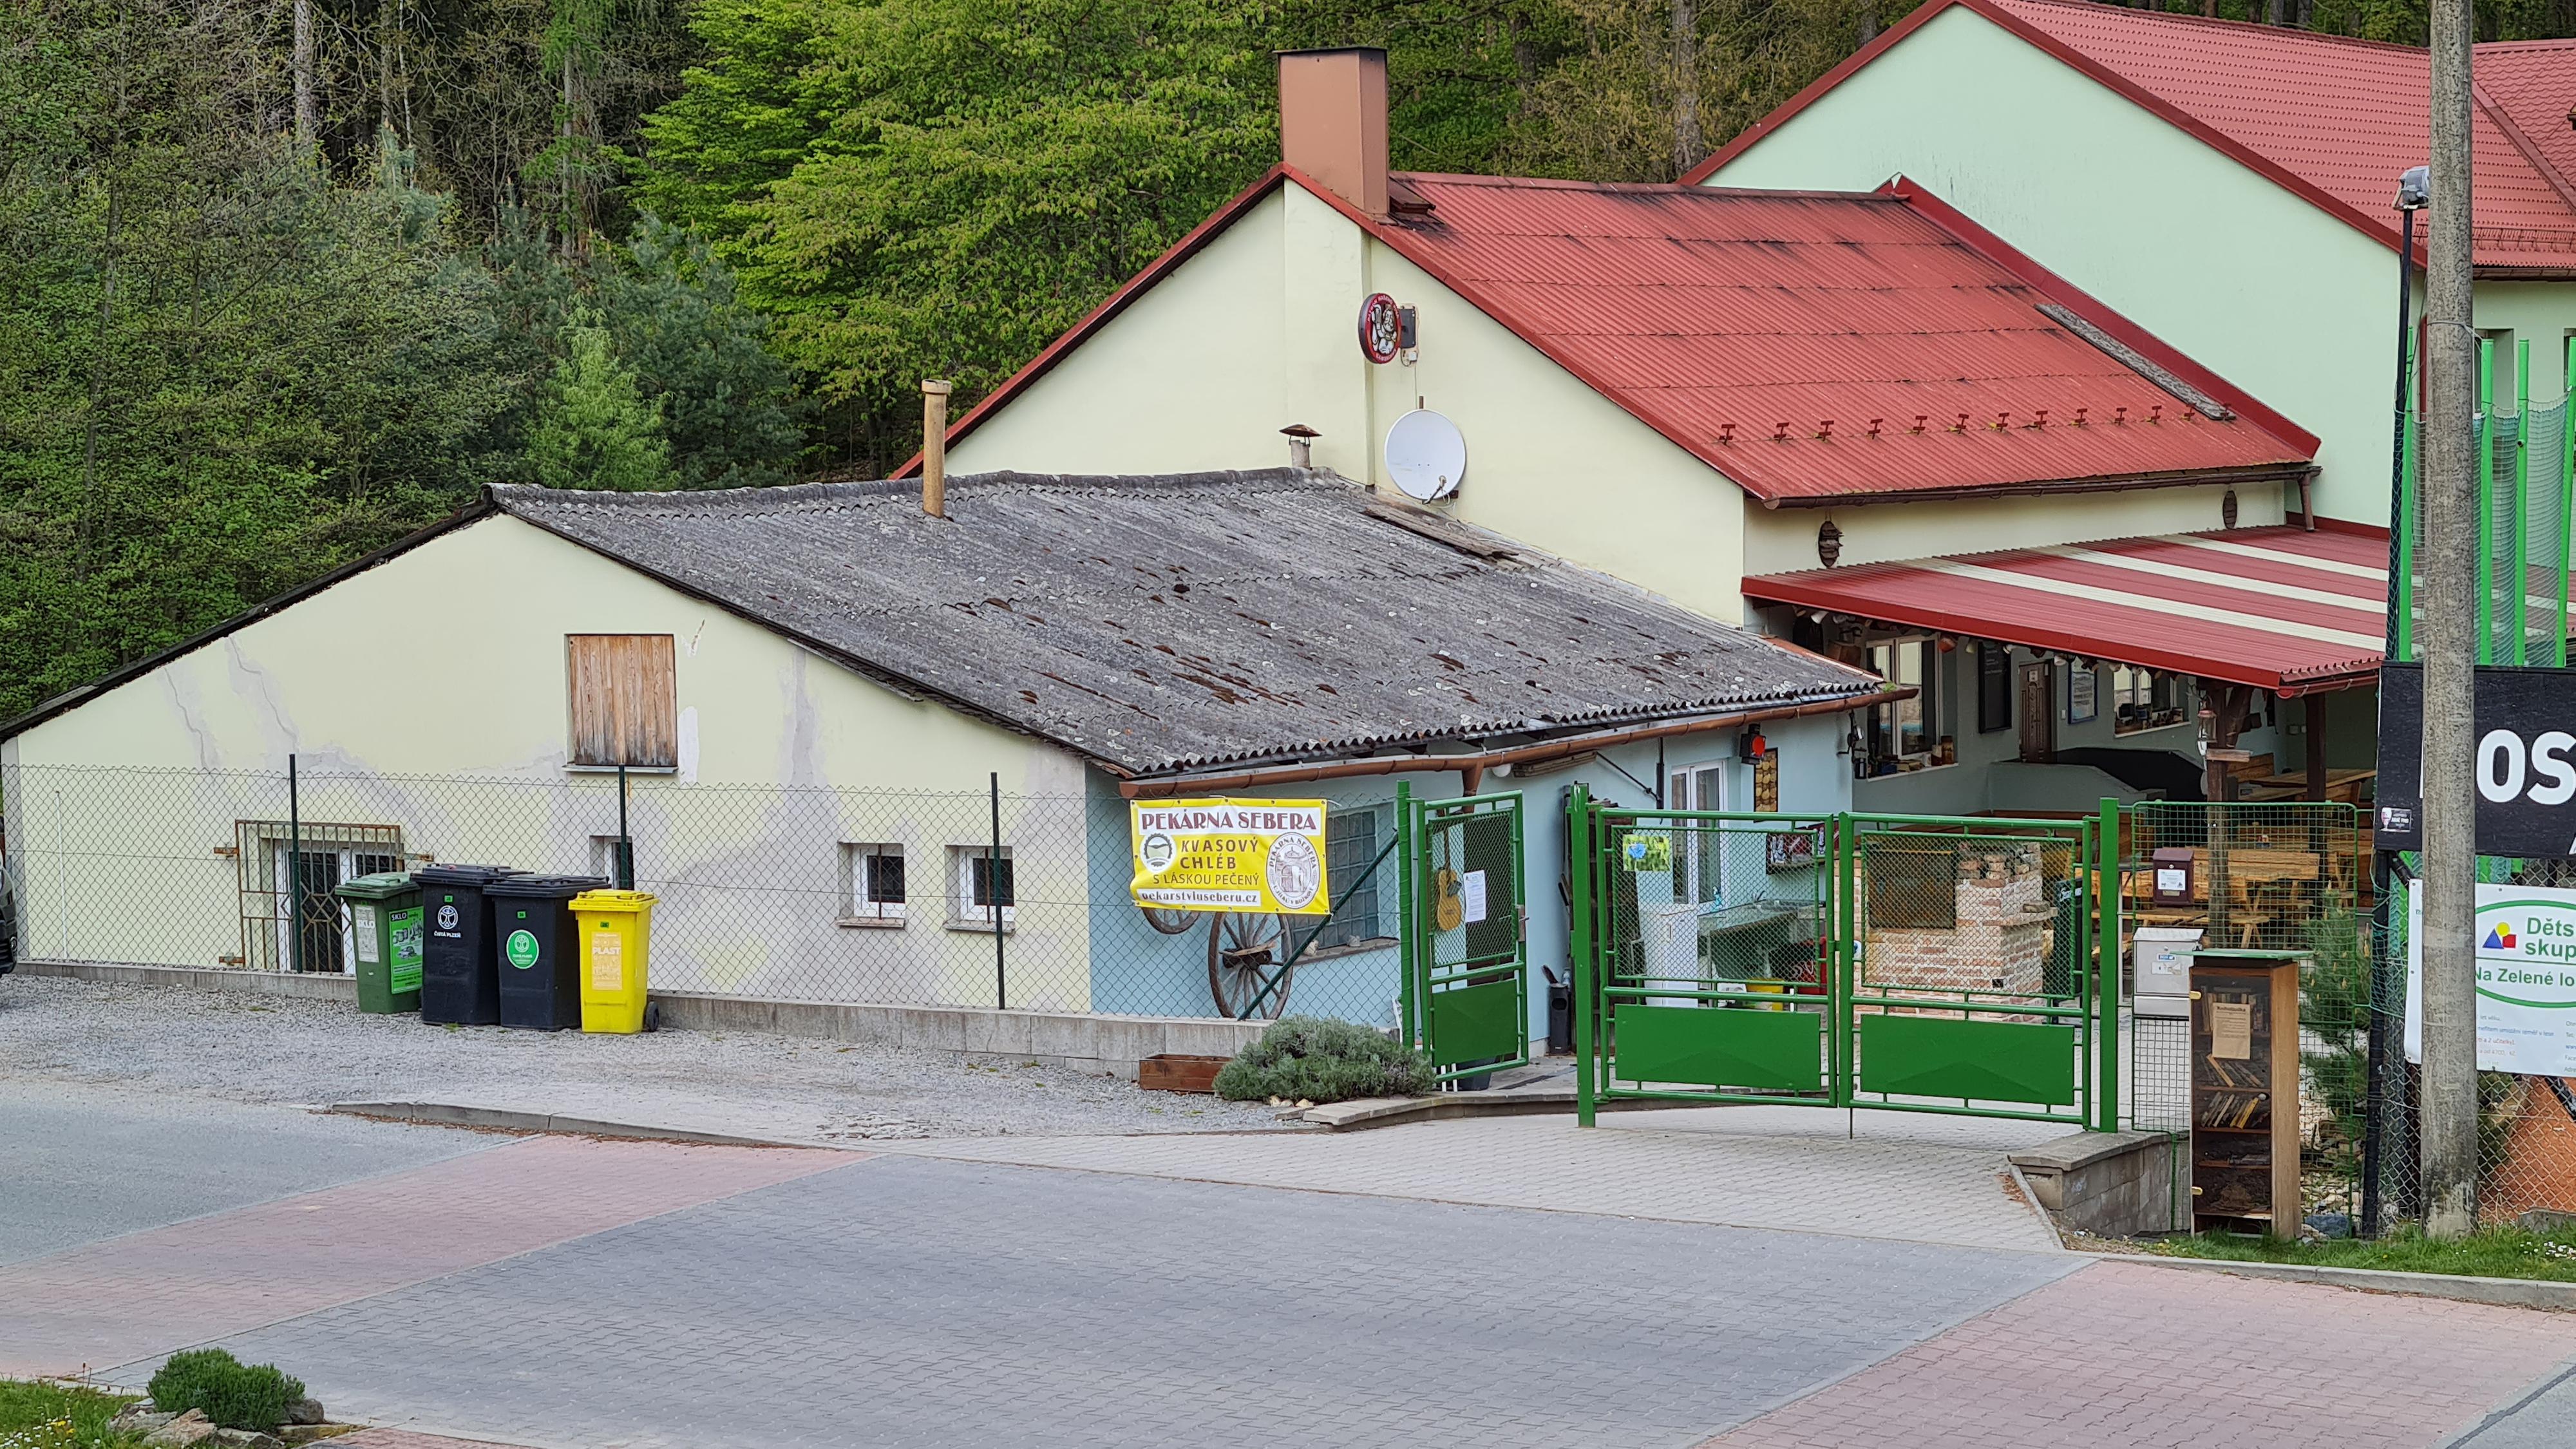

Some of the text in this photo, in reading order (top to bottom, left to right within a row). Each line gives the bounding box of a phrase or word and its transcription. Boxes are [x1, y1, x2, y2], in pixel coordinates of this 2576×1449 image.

[1141, 808, 1317, 830] PEKÁRNA SEBERA
[1181, 837, 1258, 853] KVASOVÝ
[1296, 837, 1317, 869] SEBERA
[1180, 853, 1236, 869] CHLÉB
[1153, 871, 1260, 886] S LÁSKOU PEČENÝ
[2524, 938, 2576, 962] skup
[2497, 967, 2554, 985] Zelené
